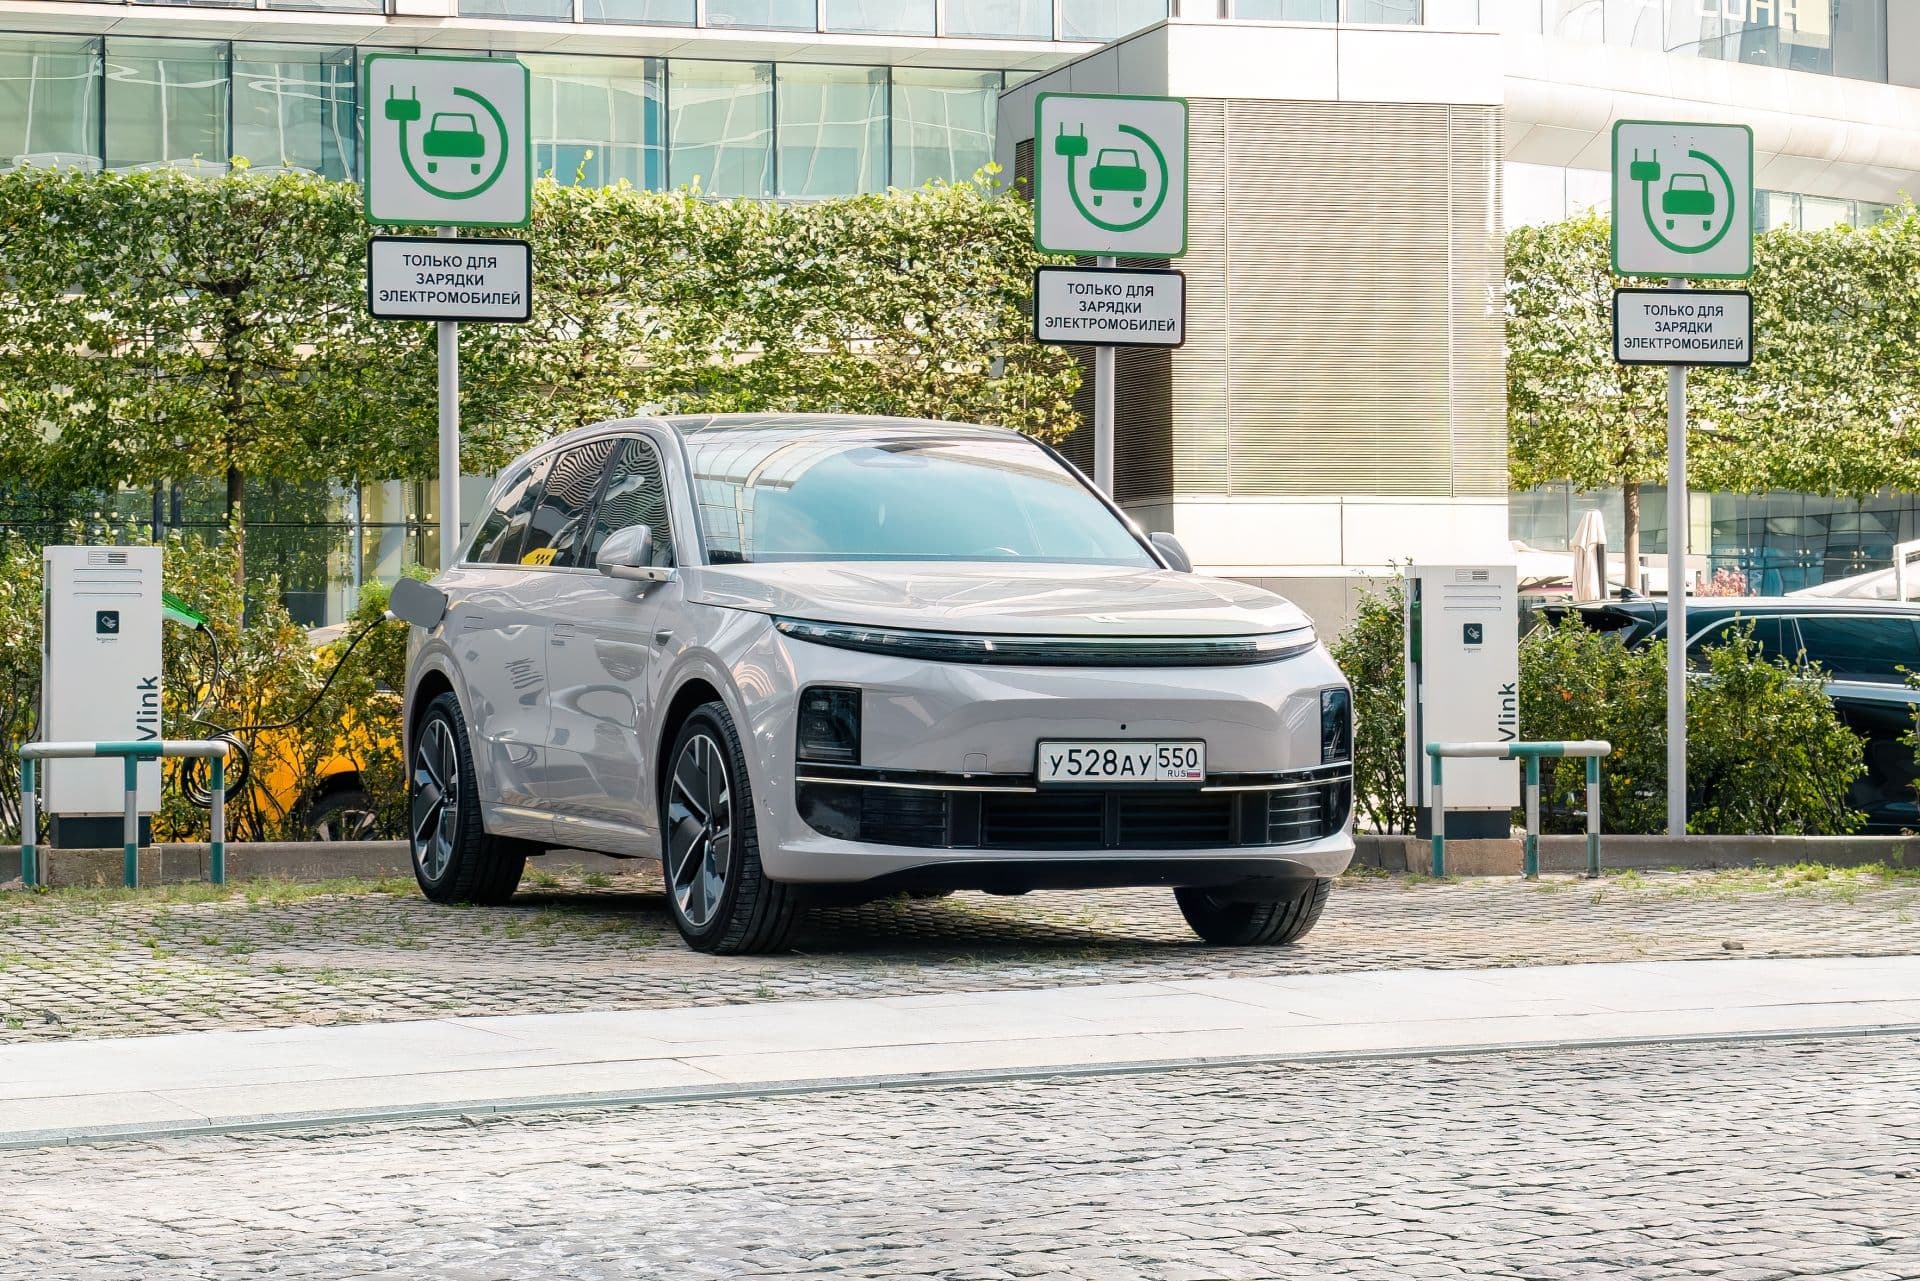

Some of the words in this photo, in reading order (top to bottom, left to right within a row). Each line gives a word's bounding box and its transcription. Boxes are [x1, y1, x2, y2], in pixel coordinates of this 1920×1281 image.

[402, 254, 463, 268] ТОЛЬКО
[466, 256, 497, 271] ДЛЯ
[415, 272, 484, 288] ЗАРЯДКИ
[379, 289, 521, 305] ЭЛЕКТРОМОБИЛЕЙ
[1066, 282, 1123, 296] ТОЛЬКО
[1125, 284, 1154, 299] ДЛЯ
[1078, 300, 1142, 316] ЗАРЯДКИ
[1643, 304, 1695, 317] ТОЛЬКО
[1697, 305, 1724, 319] ДЛЯ
[1044, 316, 1176, 332] ЭЛЕКТРОМОБИЛЕЙ
[1654, 321, 1713, 335] ЗАРЯДКИ
[1623, 336, 1744, 350] ЭЛЕКТРОМОБИЛЕЙ
[136, 675, 159, 761] Vlink
[1497, 682, 1517, 761] Vlink
[1050, 748, 1152, 777] У528АУ
[1158, 747, 1198, 768] 550
[1167, 769, 1186, 778] RUS
